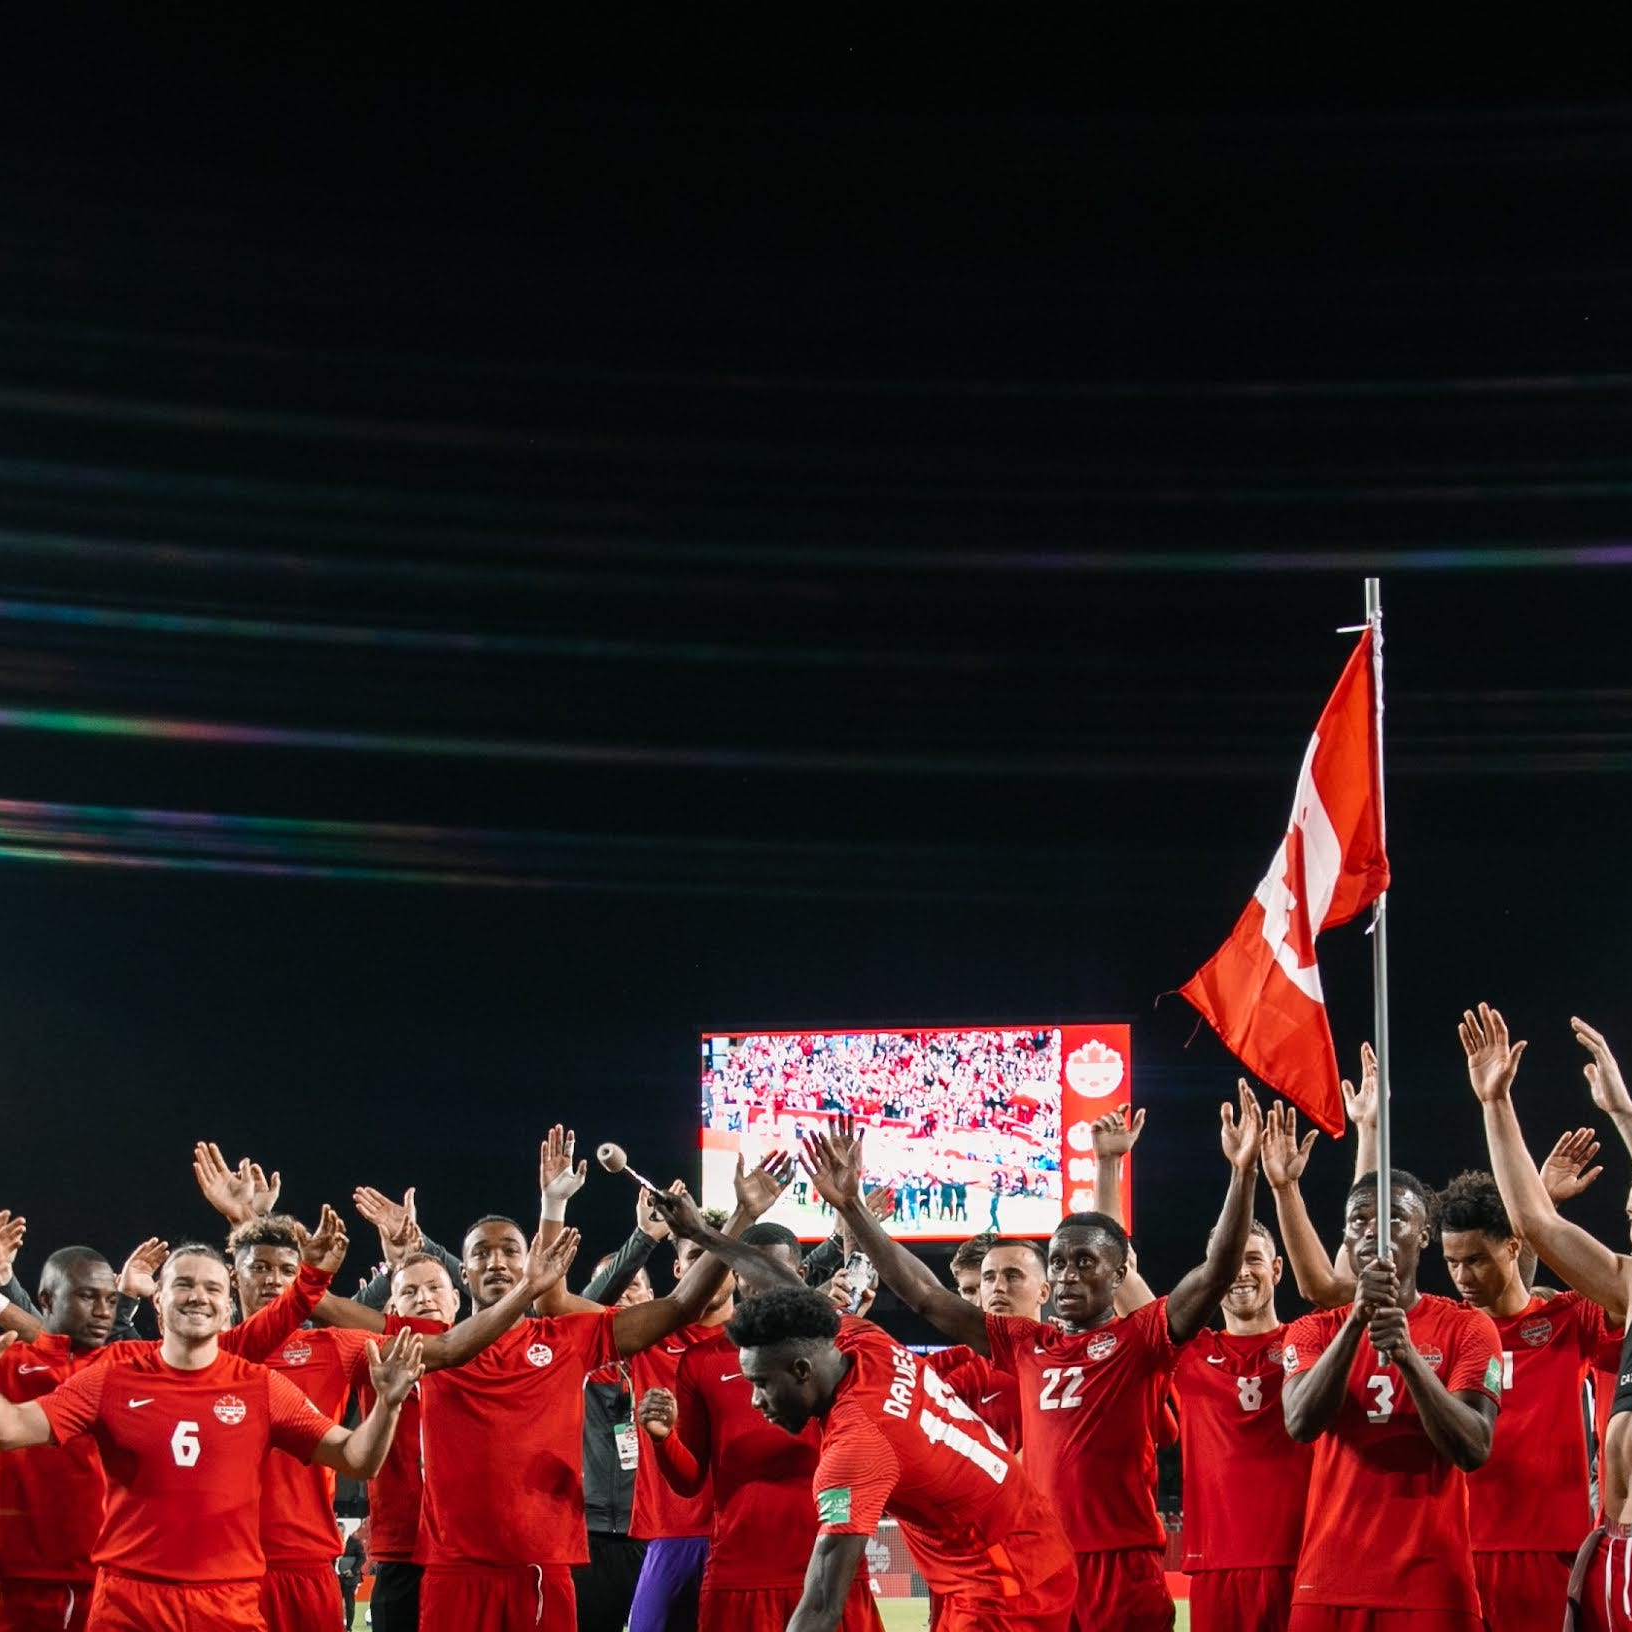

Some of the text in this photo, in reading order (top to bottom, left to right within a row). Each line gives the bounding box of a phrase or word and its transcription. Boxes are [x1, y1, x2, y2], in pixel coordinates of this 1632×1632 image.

[1522, 1324, 1551, 1337] CANADA
[1040, 1366, 1085, 1411] 22
[1236, 1376, 1263, 1412] 8
[1367, 1375, 1394, 1423] 3
[171, 1420, 201, 1467] 6
